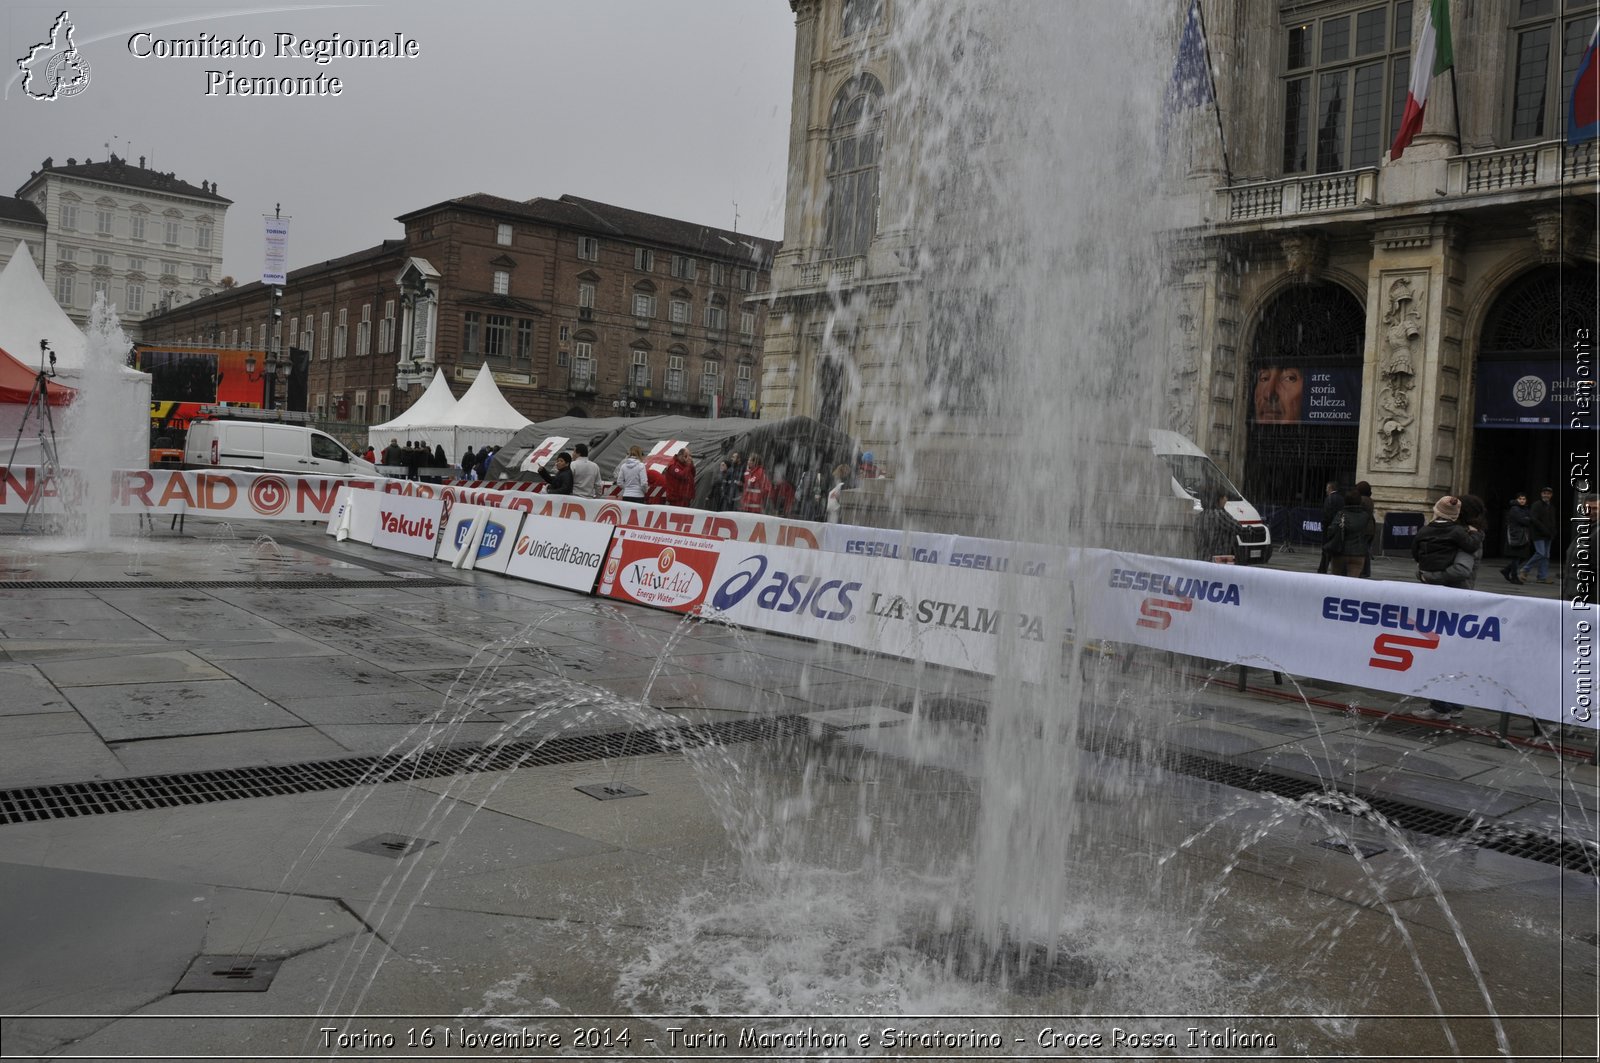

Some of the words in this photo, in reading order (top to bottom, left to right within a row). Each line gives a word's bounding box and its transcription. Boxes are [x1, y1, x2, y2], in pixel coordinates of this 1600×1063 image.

[1310, 383, 1336, 394] storia
[1311, 374, 1331, 382] arte
[1309, 395, 1346, 407] bellezza
[1308, 409, 1352, 419] emozione
[380, 511, 435, 541] Yakult
[457, 526, 499, 548] Bria
[637, 533, 651, 541] valore
[651, 536, 673, 545] aggiunto
[683, 538, 690, 546] la
[698, 541, 715, 550] salute
[528, 539, 571, 563] UniCredit
[568, 546, 601, 568] Banca
[629, 564, 695, 594] NaturAid
[1108, 568, 1240, 607] ESSELUNGA
[636, 588, 657, 602] Energy
[656, 592, 676, 603] Water
[866, 592, 904, 620] LA
[1322, 596, 1501, 642] ESSELUNGA
